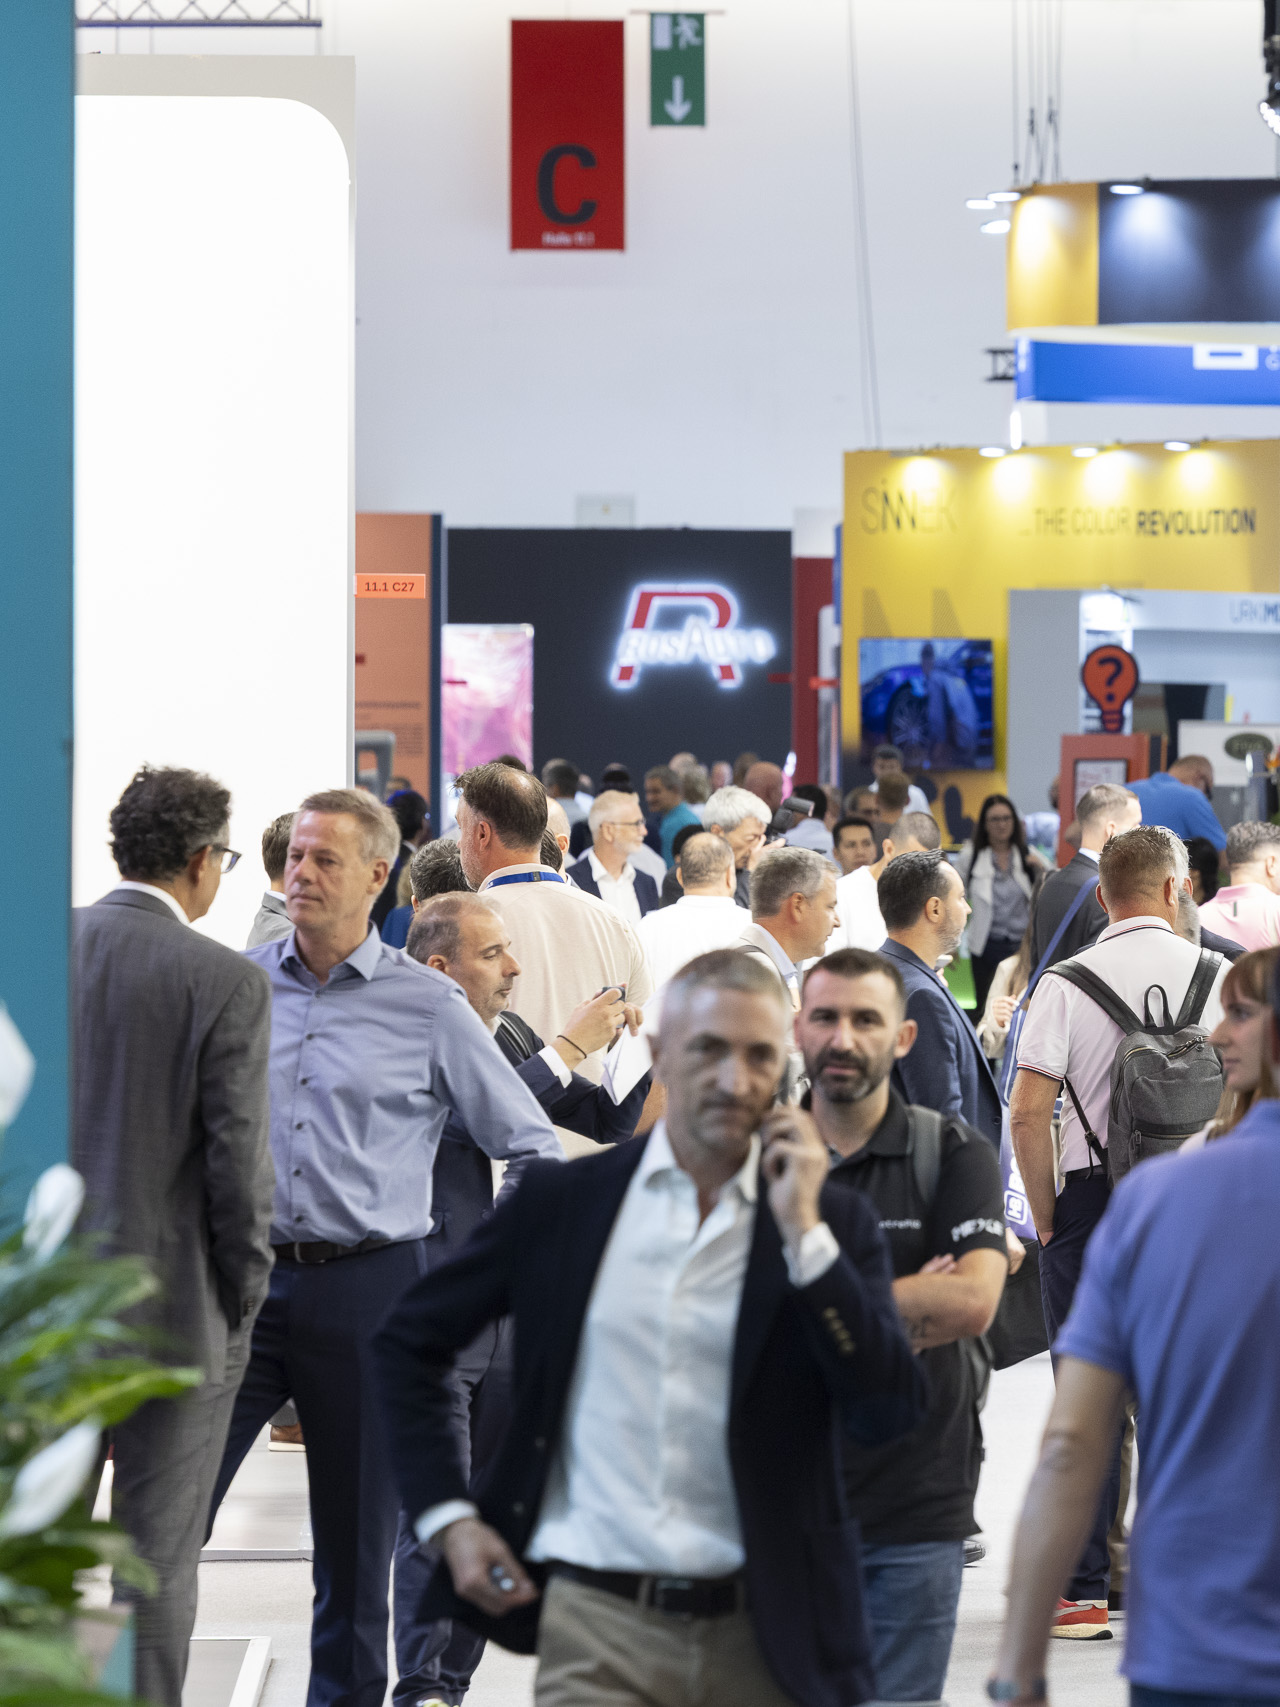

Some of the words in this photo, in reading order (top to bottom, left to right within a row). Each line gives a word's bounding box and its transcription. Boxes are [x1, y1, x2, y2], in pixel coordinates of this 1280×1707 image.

[537, 143, 598, 226] C
[1136, 507, 1258, 536] REVOLUTION
[364, 582, 389, 592] 11.1
[392, 582, 415, 592] C27
